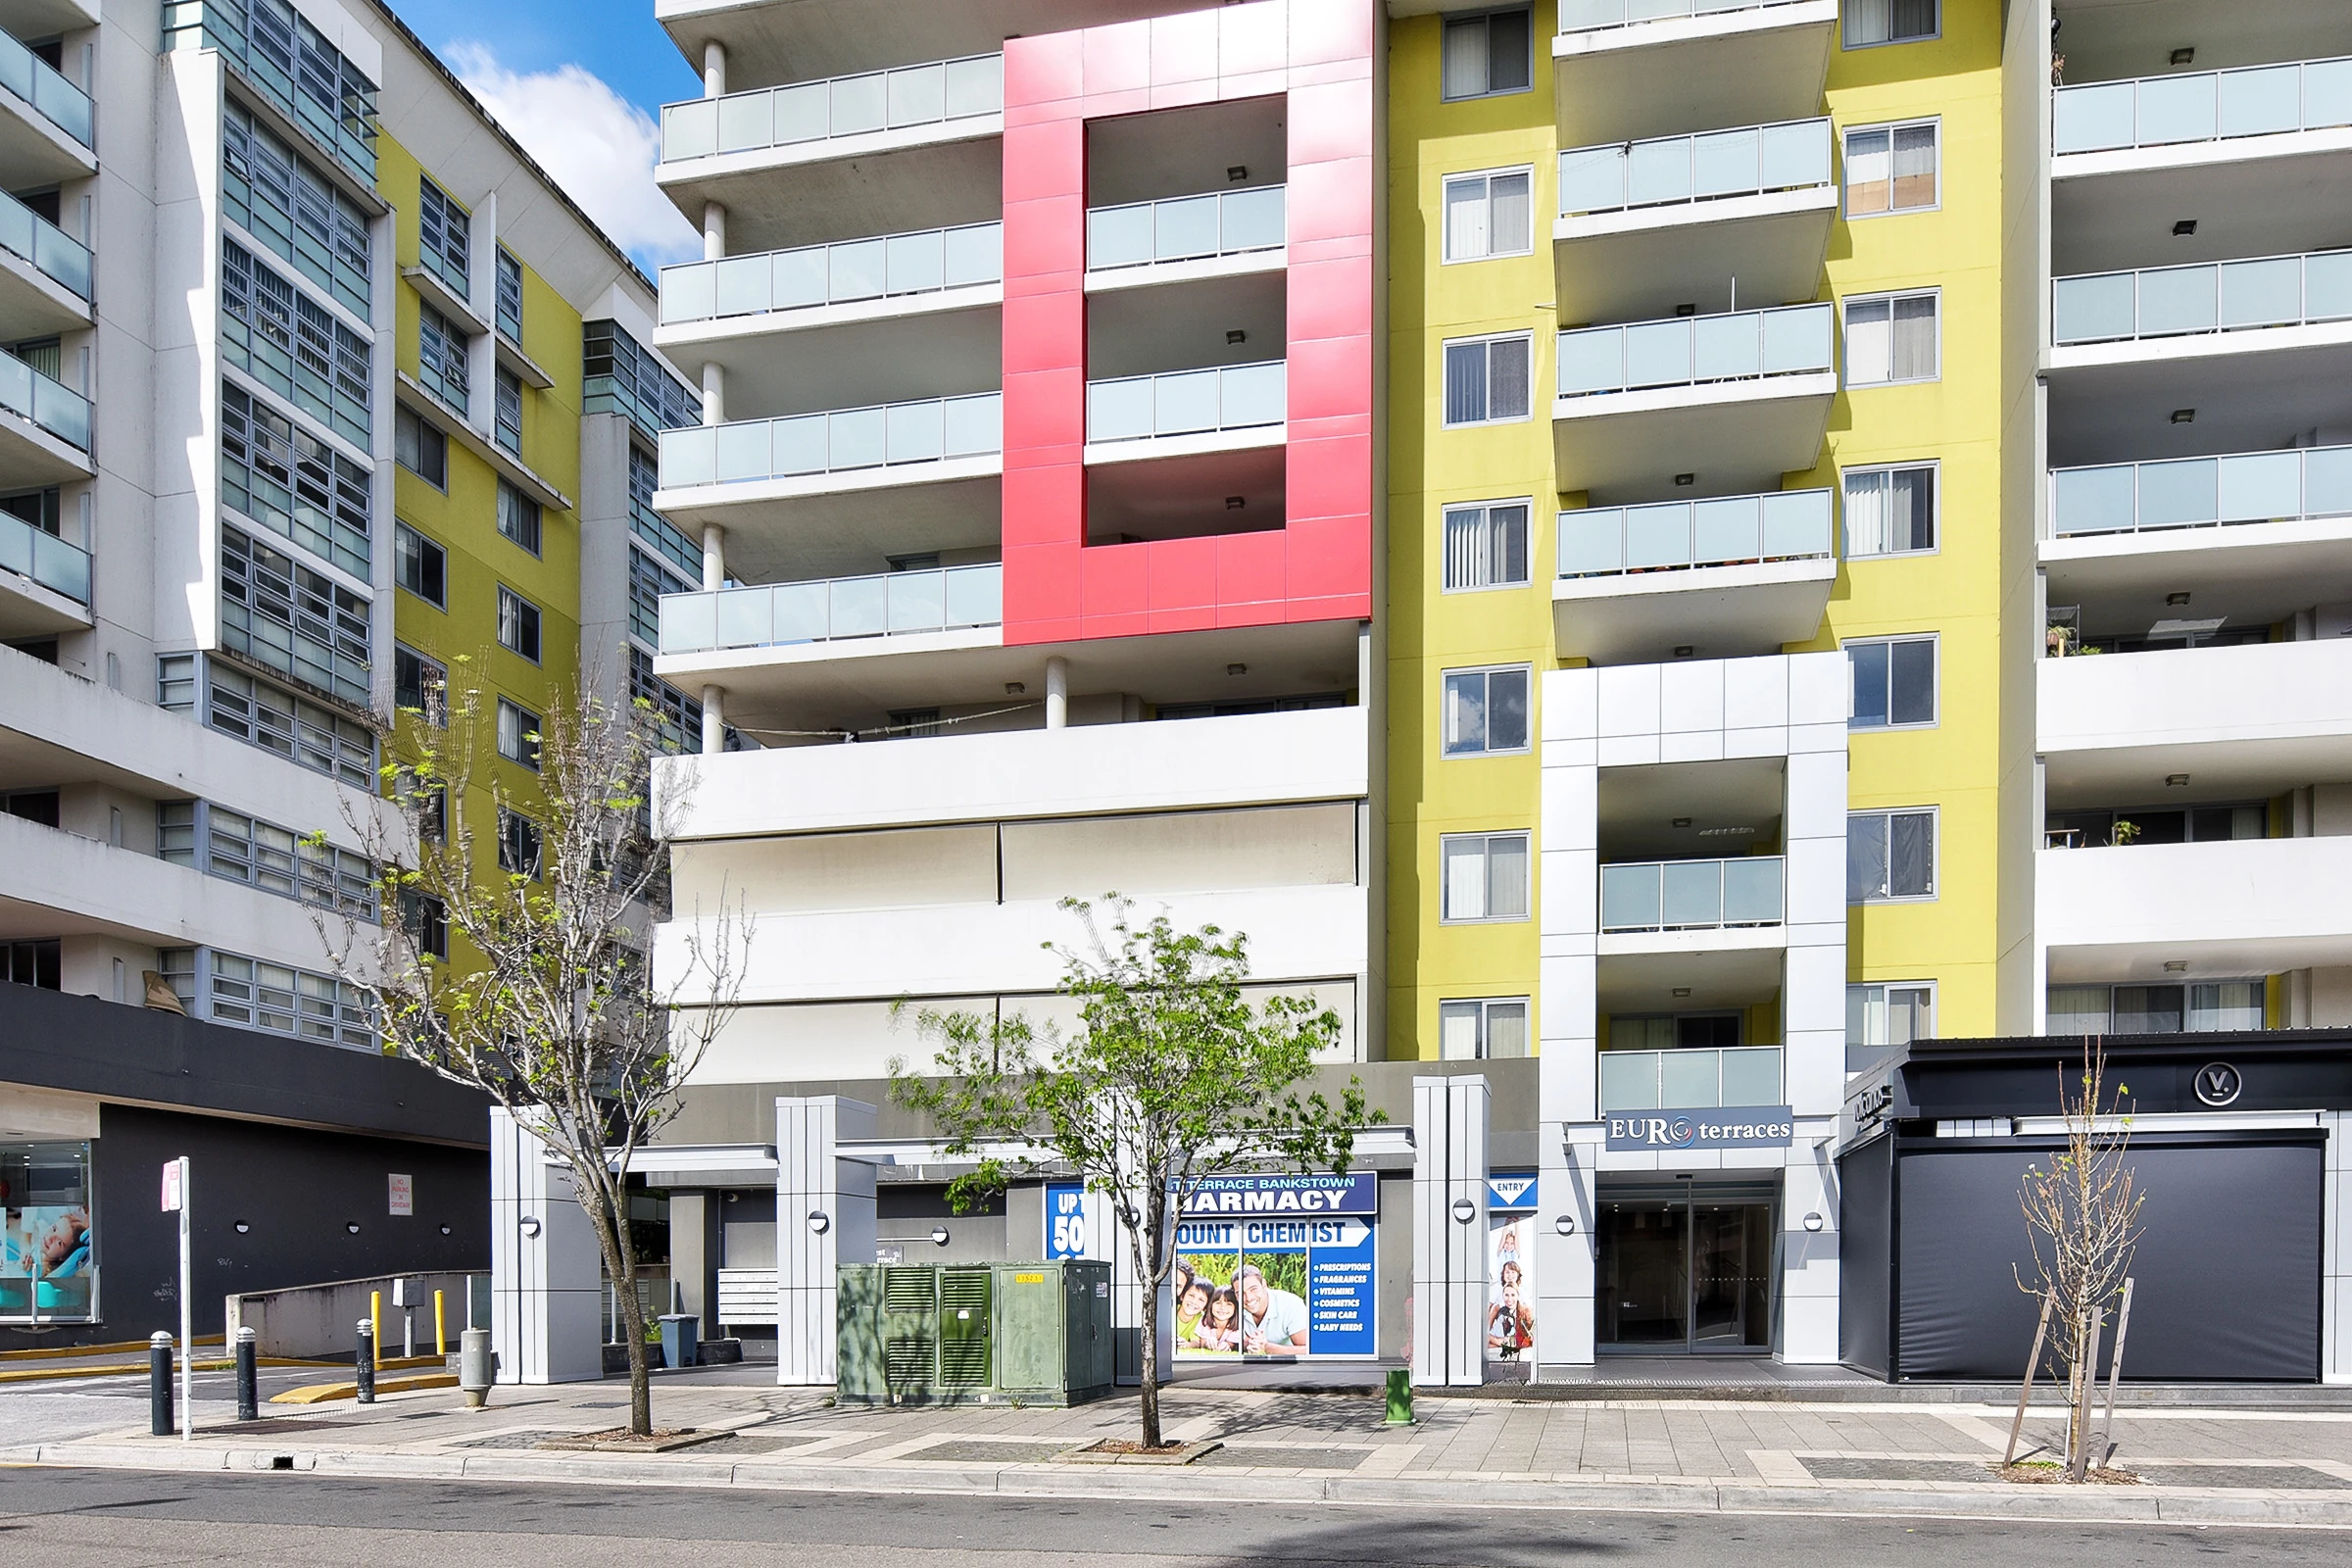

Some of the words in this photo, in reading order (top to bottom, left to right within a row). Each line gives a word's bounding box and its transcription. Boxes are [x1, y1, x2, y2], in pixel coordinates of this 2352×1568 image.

[1698, 1122, 1790, 1140] terraces
[1186, 1179, 1254, 1190] TERRACE
[1259, 1177, 1355, 1189] BANKSTOWN
[1497, 1182, 1524, 1192] ENTRY
[1058, 1193, 1078, 1214] UP
[1171, 1190, 1348, 1212] HARMACY
[1177, 1223, 1234, 1244] OUNT
[1248, 1222, 1347, 1243] CHEMIST
[1319, 1262, 1371, 1271] PRESCRIPTIONS
[1319, 1287, 1354, 1296] VITAMINS
[1319, 1298, 1360, 1307] COSMETICS
[1338, 1310, 1357, 1319] CARE
